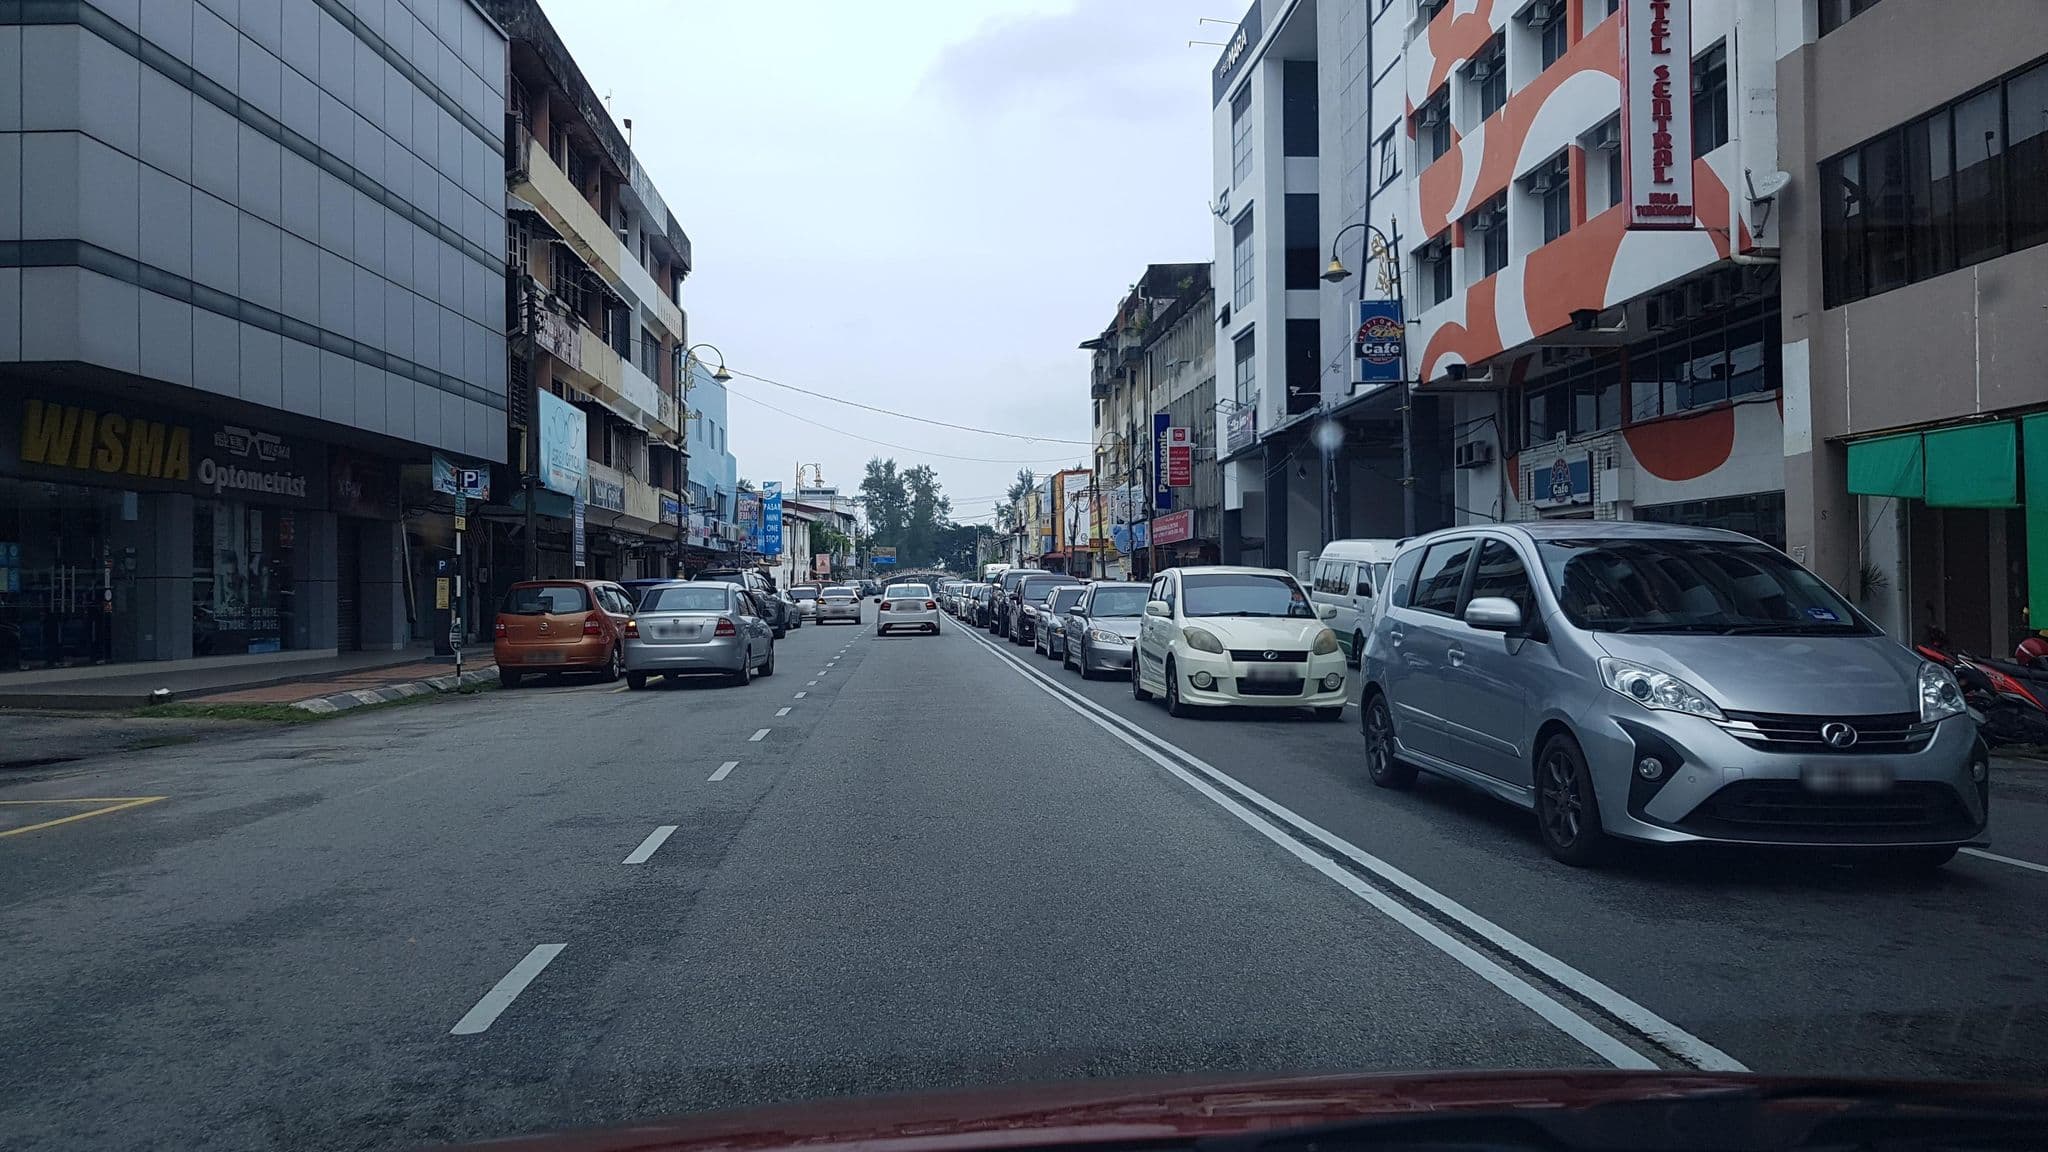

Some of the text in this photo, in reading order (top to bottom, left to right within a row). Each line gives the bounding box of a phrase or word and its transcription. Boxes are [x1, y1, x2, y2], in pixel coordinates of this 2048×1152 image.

[1650, 0, 1673, 184] TEL SENTRAL
[1361, 343, 1400, 354] Cafe
[21, 400, 191, 480] WISMA
[1158, 431, 1168, 493] Panasonic
[198, 458, 306, 498] Optometrist
[463, 471, 477, 487] P
[1553, 484, 1569, 495] Cafe
[766, 524, 779, 532] ONE
[766, 535, 779, 543] STOP
[438, 560, 446, 570] P
